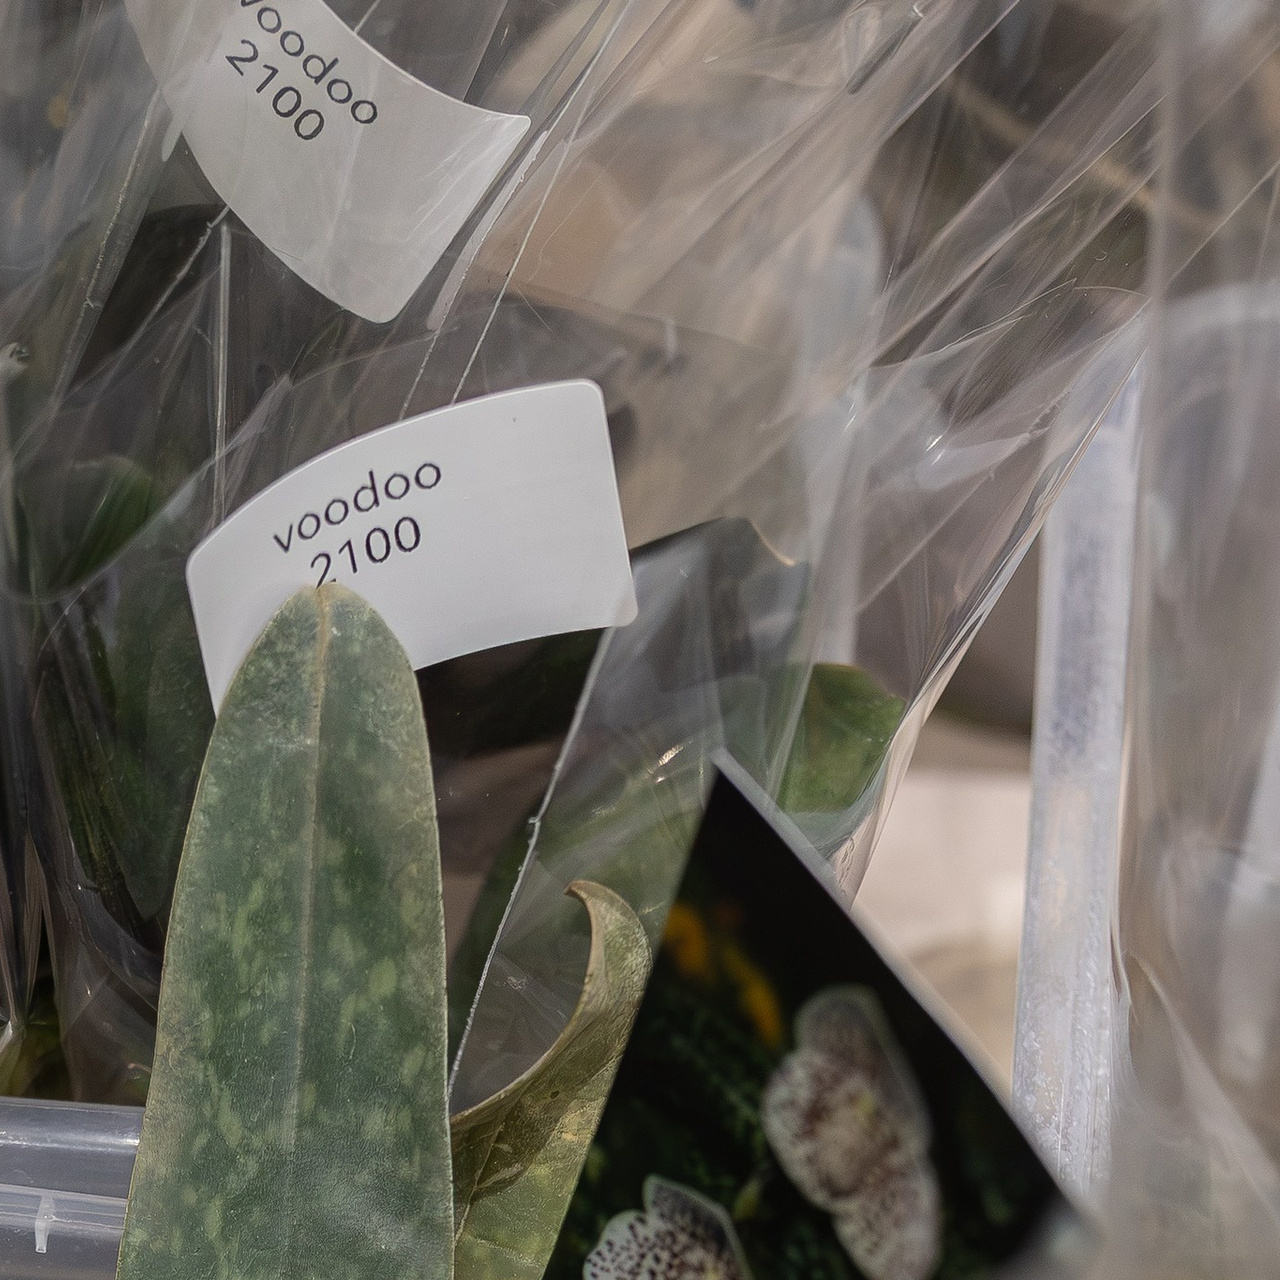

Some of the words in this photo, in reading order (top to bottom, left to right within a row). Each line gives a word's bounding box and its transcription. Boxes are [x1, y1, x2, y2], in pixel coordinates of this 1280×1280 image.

[224, 38, 326, 141] 2100
[272, 460, 442, 554] voodoo
[309, 516, 422, 588] 2100
